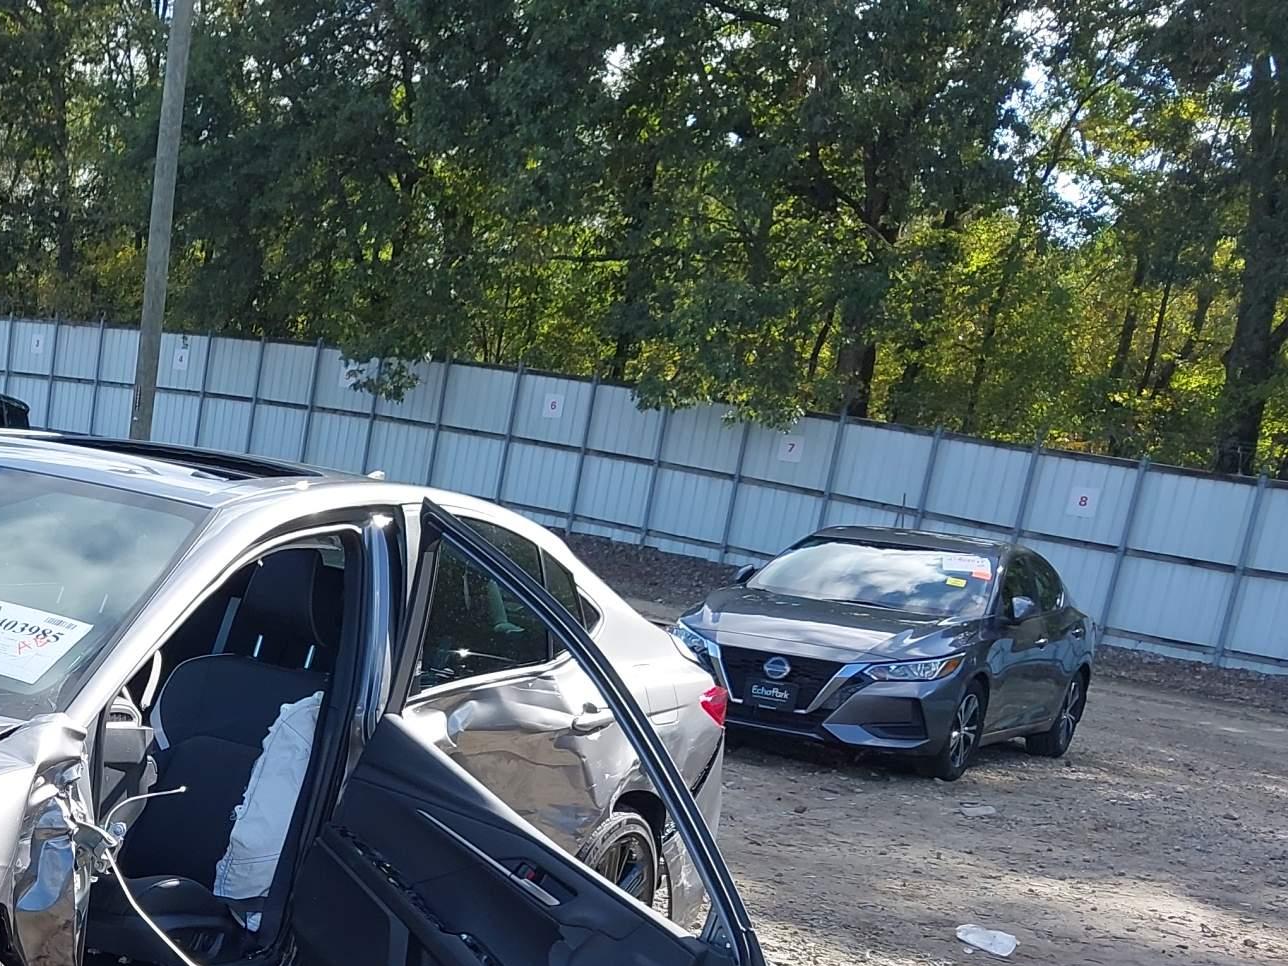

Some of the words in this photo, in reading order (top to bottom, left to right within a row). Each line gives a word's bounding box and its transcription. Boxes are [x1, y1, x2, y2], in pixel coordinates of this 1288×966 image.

[550, 400, 558, 410] 6
[787, 442, 796, 453] 7
[1078, 495, 1089, 507] 8
[751, 684, 790, 700] EchoPark
